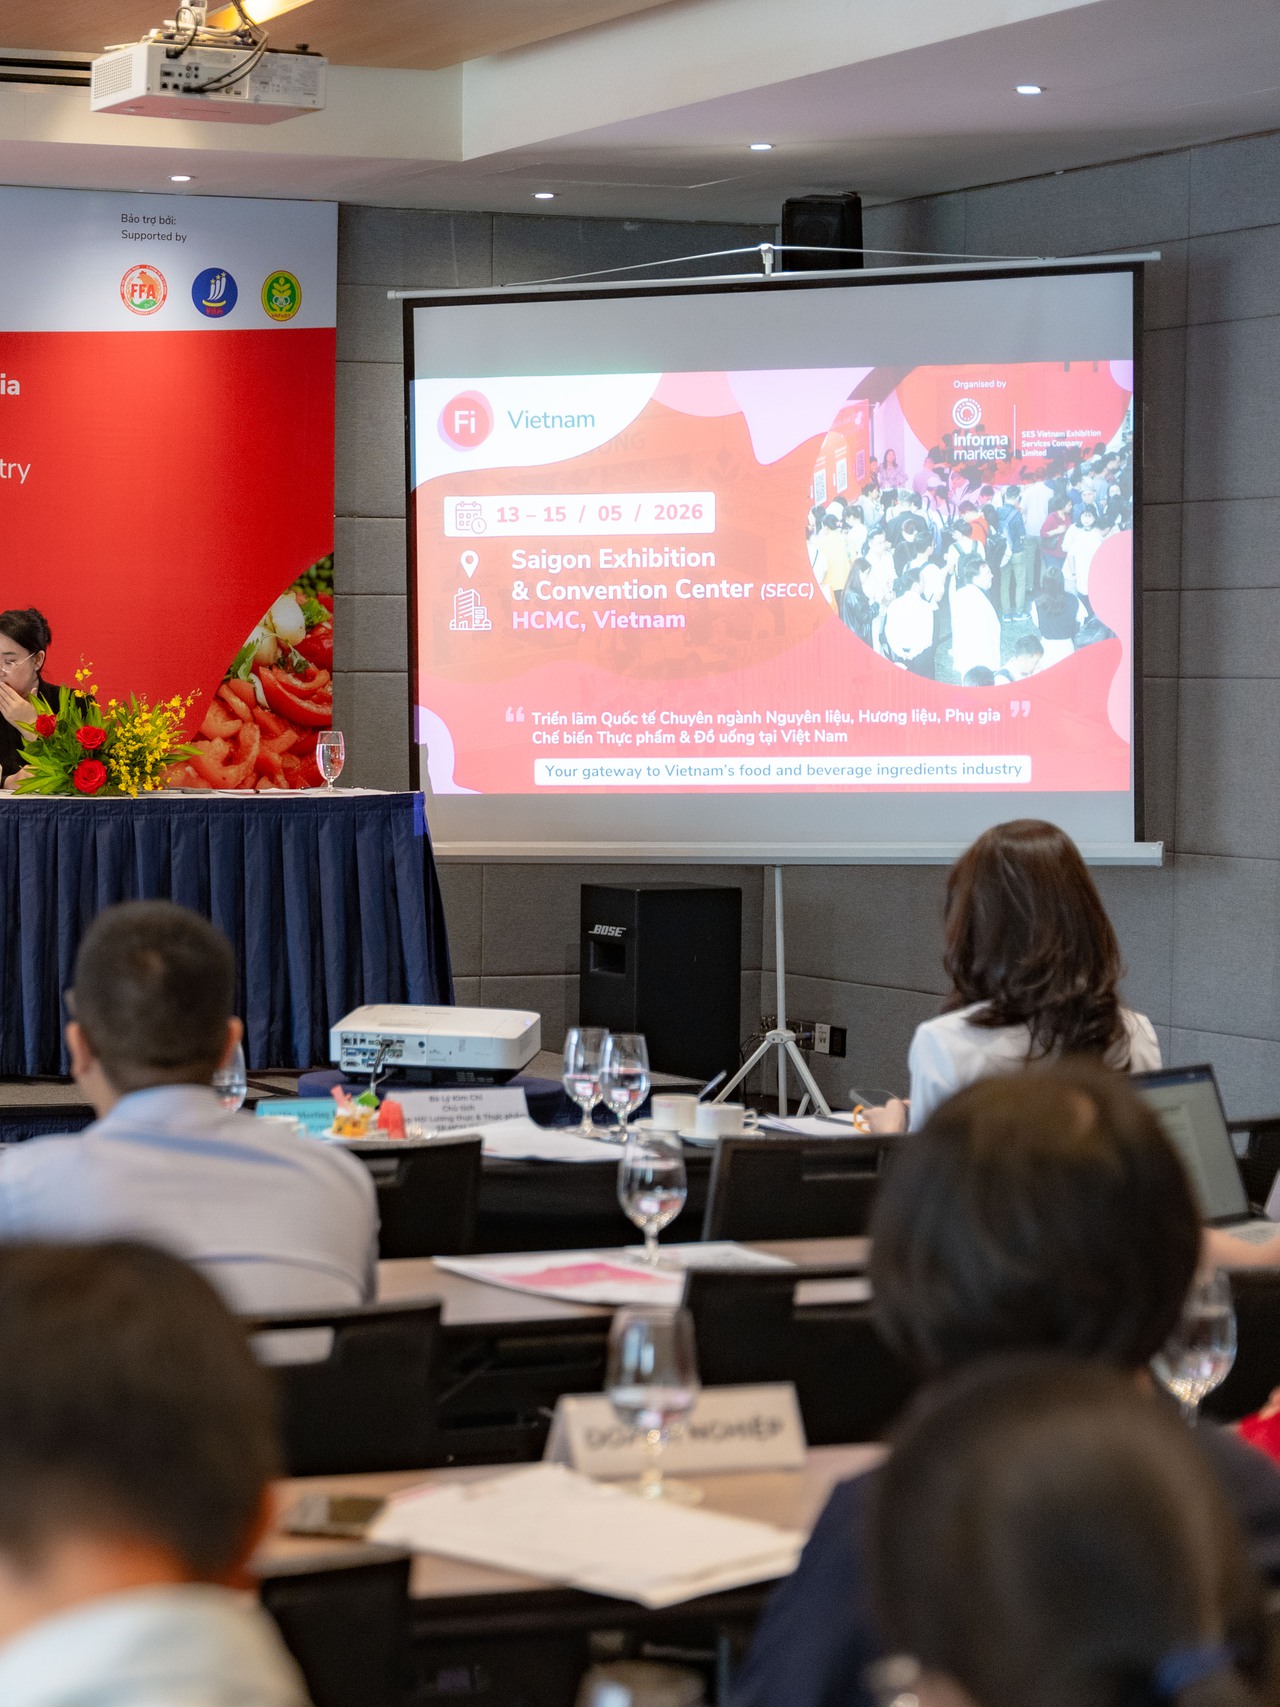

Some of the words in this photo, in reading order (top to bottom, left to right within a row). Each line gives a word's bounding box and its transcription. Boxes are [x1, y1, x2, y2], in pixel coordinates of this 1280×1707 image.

[121, 213, 140, 224] Bảo
[142, 215, 157, 226] trợ
[159, 214, 177, 225] bởi:
[121, 230, 172, 242] Supported
[175, 231, 187, 243] by
[131, 283, 156, 299] FFA
[953, 380, 995, 390] Organised
[996, 380, 1007, 389] by
[454, 410, 476, 434] Fi
[507, 410, 596, 430] Vietnam
[954, 432, 1008, 446] informa
[1021, 430, 1036, 438] SES
[1037, 430, 1065, 438] Vietnam
[1066, 429, 1101, 437] Exhibition
[1021, 440, 1051, 448] Services
[1052, 440, 1083, 449] Company
[954, 447, 1007, 460] markets
[1021, 449, 1047, 457] Limited
[496, 505, 519, 523] 13
[543, 505, 567, 522] 15
[578, 505, 586, 524] /
[597, 505, 622, 521] 05
[633, 504, 642, 523] /
[654, 504, 703, 521] 2026
[512, 548, 591, 574] Saigon
[599, 547, 716, 569] Exhibition
[512, 581, 529, 601] &
[535, 580, 668, 601] Convention
[675, 579, 754, 600] Center
[760, 582, 815, 601] (SECC)
[512, 610, 586, 632] HCMC,
[593, 609, 686, 629] Vietnam
[532, 711, 568, 725] Triển
[571, 711, 597, 725] lãm
[601, 710, 638, 728] Quốc
[641, 710, 657, 725] tế
[660, 711, 713, 727] Chuyên
[717, 710, 761, 727] ngành
[766, 710, 821, 726] Nguyên
[825, 710, 854, 726] liệu,
[859, 709, 908, 726] Hương
[912, 708, 941, 725] liệu,
[946, 708, 974, 725] Phụ
[978, 708, 1001, 725] gia
[532, 730, 560, 744] Chế
[564, 730, 593, 744] biến
[597, 731, 632, 746] Thực
[636, 729, 675, 746] phẩm
[679, 731, 691, 743] &
[694, 729, 715, 744] Đồ
[719, 729, 755, 745] uống
[759, 730, 777, 745] tại
[781, 729, 811, 745] Việt
[814, 729, 848, 743] Nam
[545, 765, 578, 777] Your
[582, 766, 642, 780] gateway
[647, 766, 660, 777] to
[739, 764, 771, 776] food
[776, 764, 802, 776] and
[807, 764, 873, 778] beverage
[877, 763, 958, 778] ingredients
[962, 763, 1023, 778] industry
[588, 924, 627, 937] BOSE
